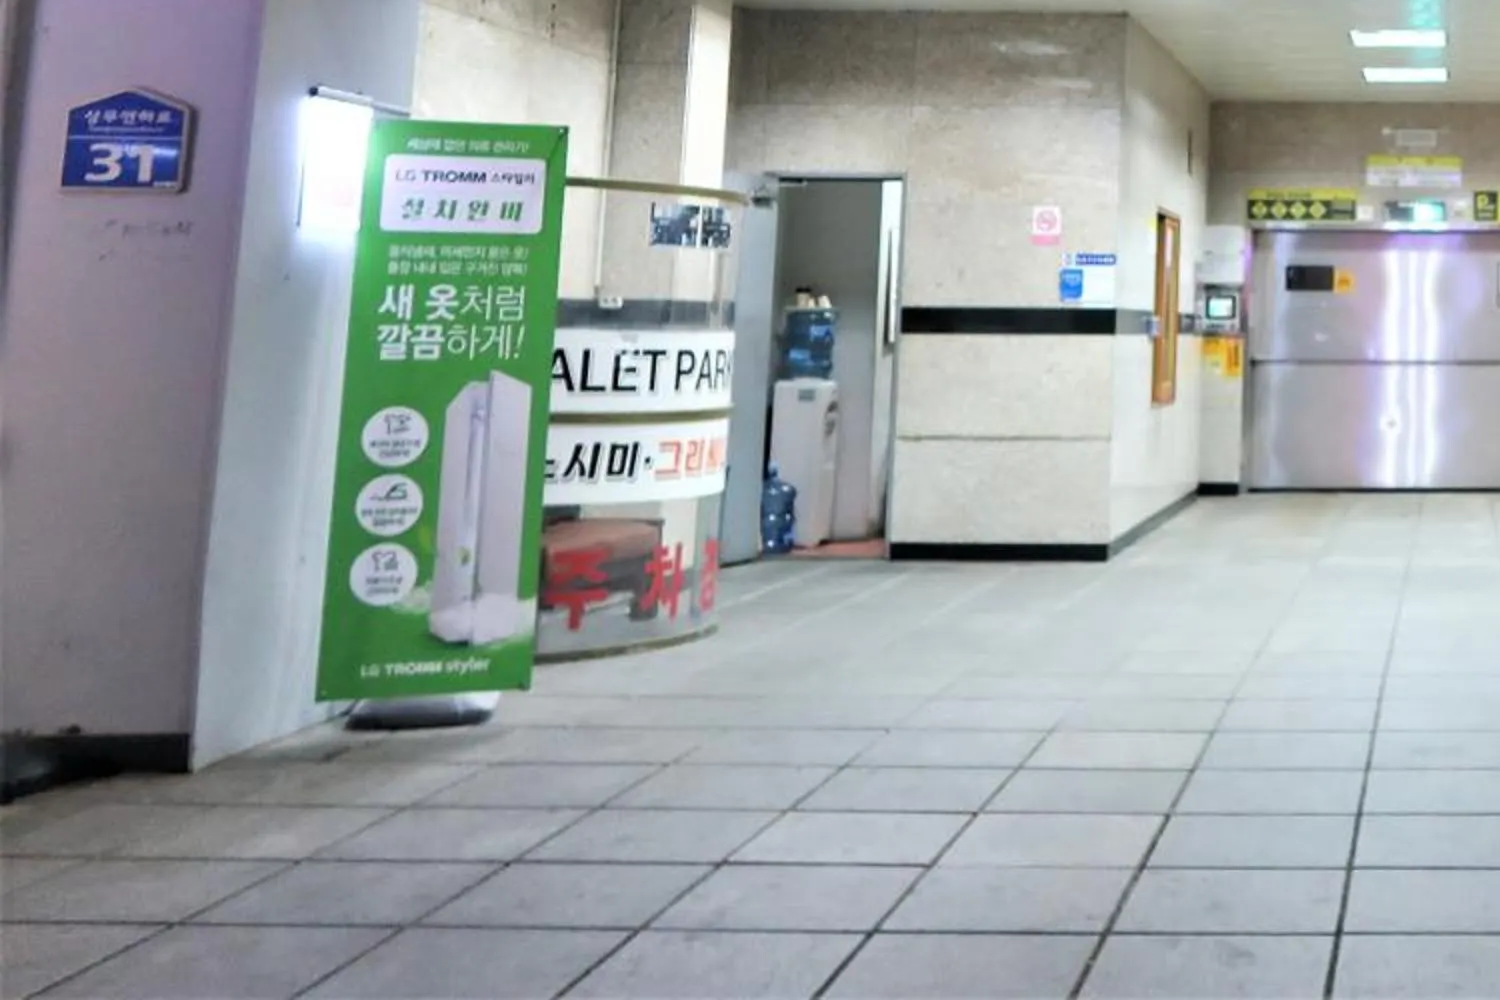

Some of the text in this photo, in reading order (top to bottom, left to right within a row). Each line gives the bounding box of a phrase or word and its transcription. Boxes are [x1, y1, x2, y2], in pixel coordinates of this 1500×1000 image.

[85, 143, 156, 183] 31
[396, 169, 416, 182] LG
[422, 169, 487, 183] TROMM
[377, 284, 526, 322] 새 옷처럼
[377, 323, 527, 361] 깔끔하게!
[673, 349, 732, 392] PAR
